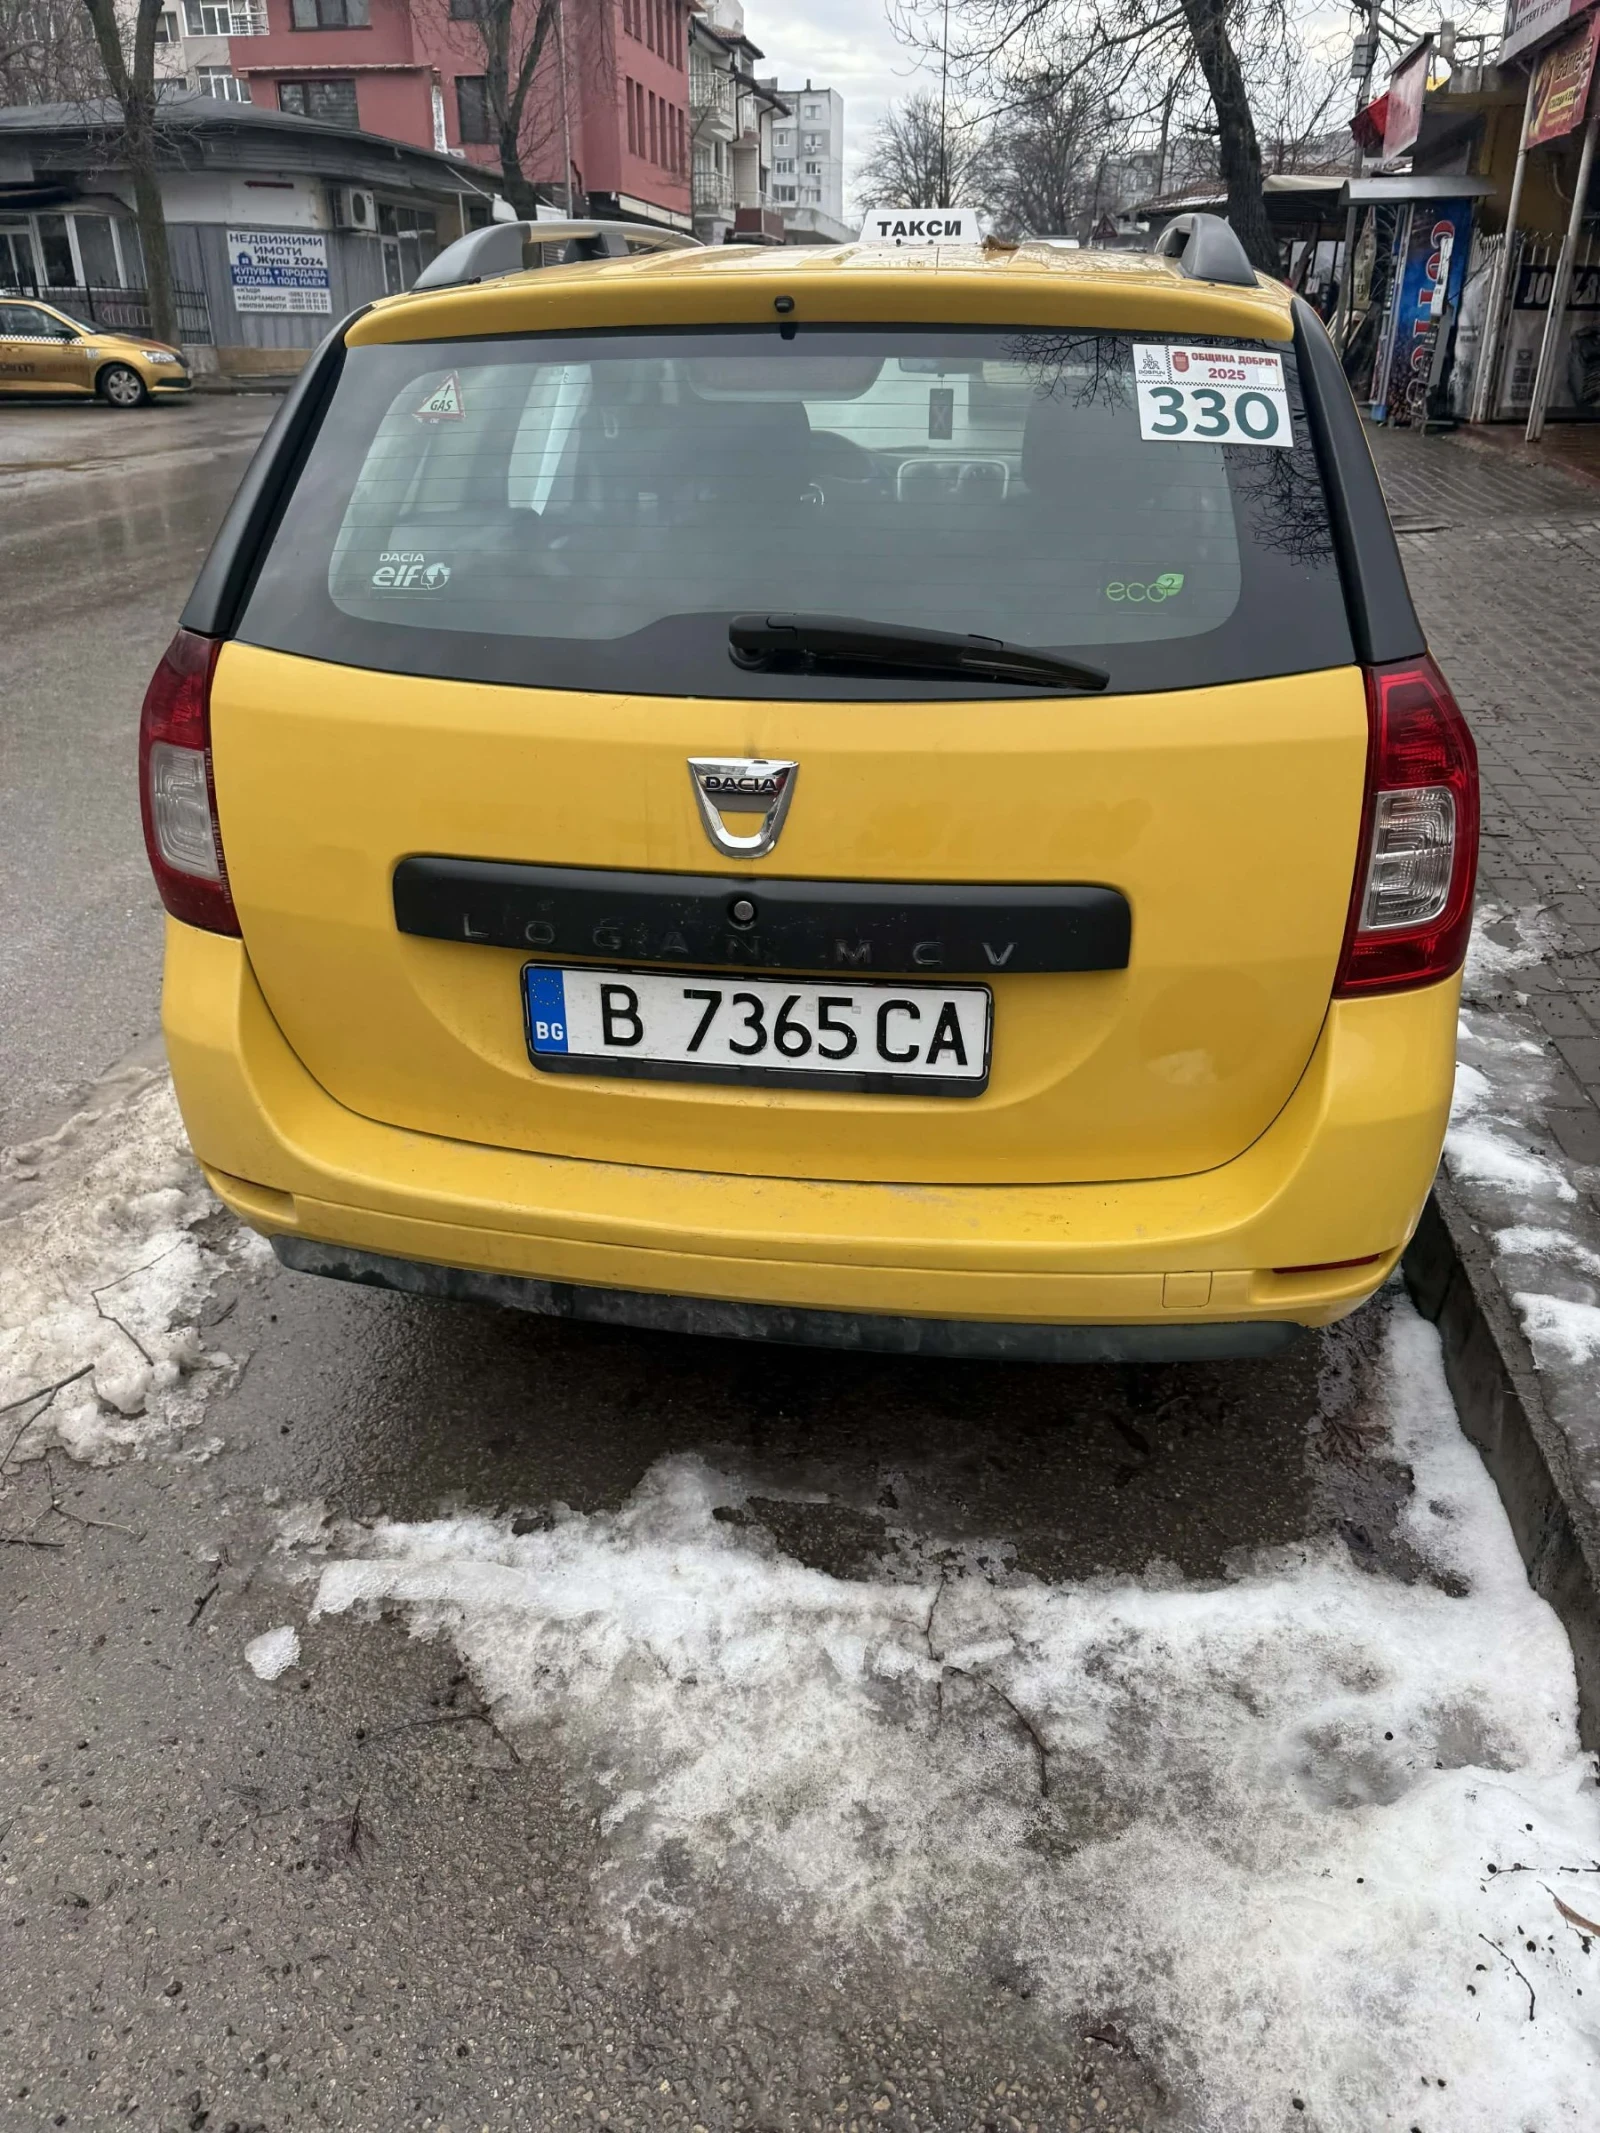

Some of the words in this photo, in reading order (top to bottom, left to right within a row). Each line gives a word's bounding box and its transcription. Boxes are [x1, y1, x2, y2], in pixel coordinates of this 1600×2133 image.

[877, 220, 962, 237] ТАКСИ
[229, 233, 323, 246] НЕДВИЖИМИ
[253, 246, 302, 256] ИМОТИ
[294, 257, 323, 266] 2024
[233, 267, 272, 276] КУПУВА
[281, 269, 327, 278] ПРОДАВА
[236, 276, 275, 285] ОТДАВА
[276, 277, 298, 287] ПОД
[299, 278, 326, 287] НАЕМ
[1191, 352, 1236, 363] ОБЩИНА
[1238, 355, 1278, 367] ДОБРИЧ
[1208, 367, 1246, 380] 2025
[430, 400, 453, 411] GAS
[1148, 386, 1279, 440] 330
[380, 553, 425, 562] DACIA
[372, 564, 424, 587] elf
[705, 776, 777, 792] DACIA
[464, 913, 762, 956] LOGAN
[835, 939, 1018, 966] MCV
[536, 1020, 564, 1041] BG
[601, 984, 645, 1047] B
[683, 988, 858, 1060] 7365
[876, 999, 969, 1066] CA
